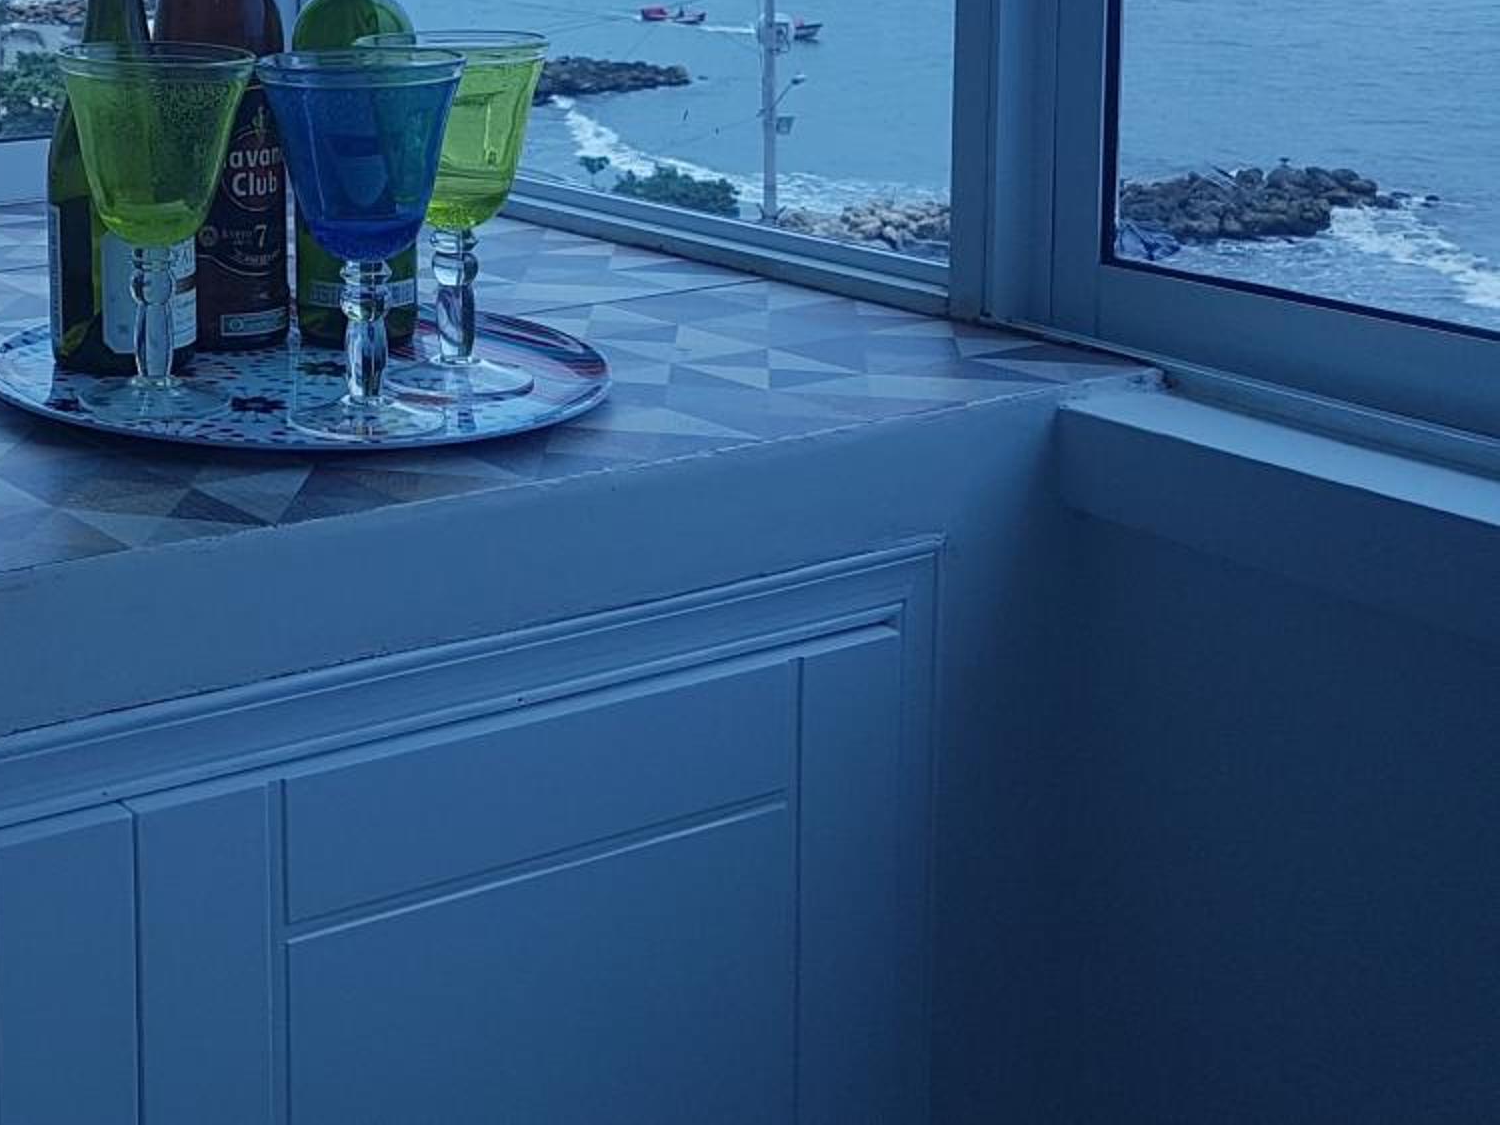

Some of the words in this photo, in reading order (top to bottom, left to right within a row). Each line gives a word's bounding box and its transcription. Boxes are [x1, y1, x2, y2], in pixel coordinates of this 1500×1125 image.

[223, 147, 281, 169] avan
[231, 170, 277, 196] Club
[255, 224, 267, 248] 7
